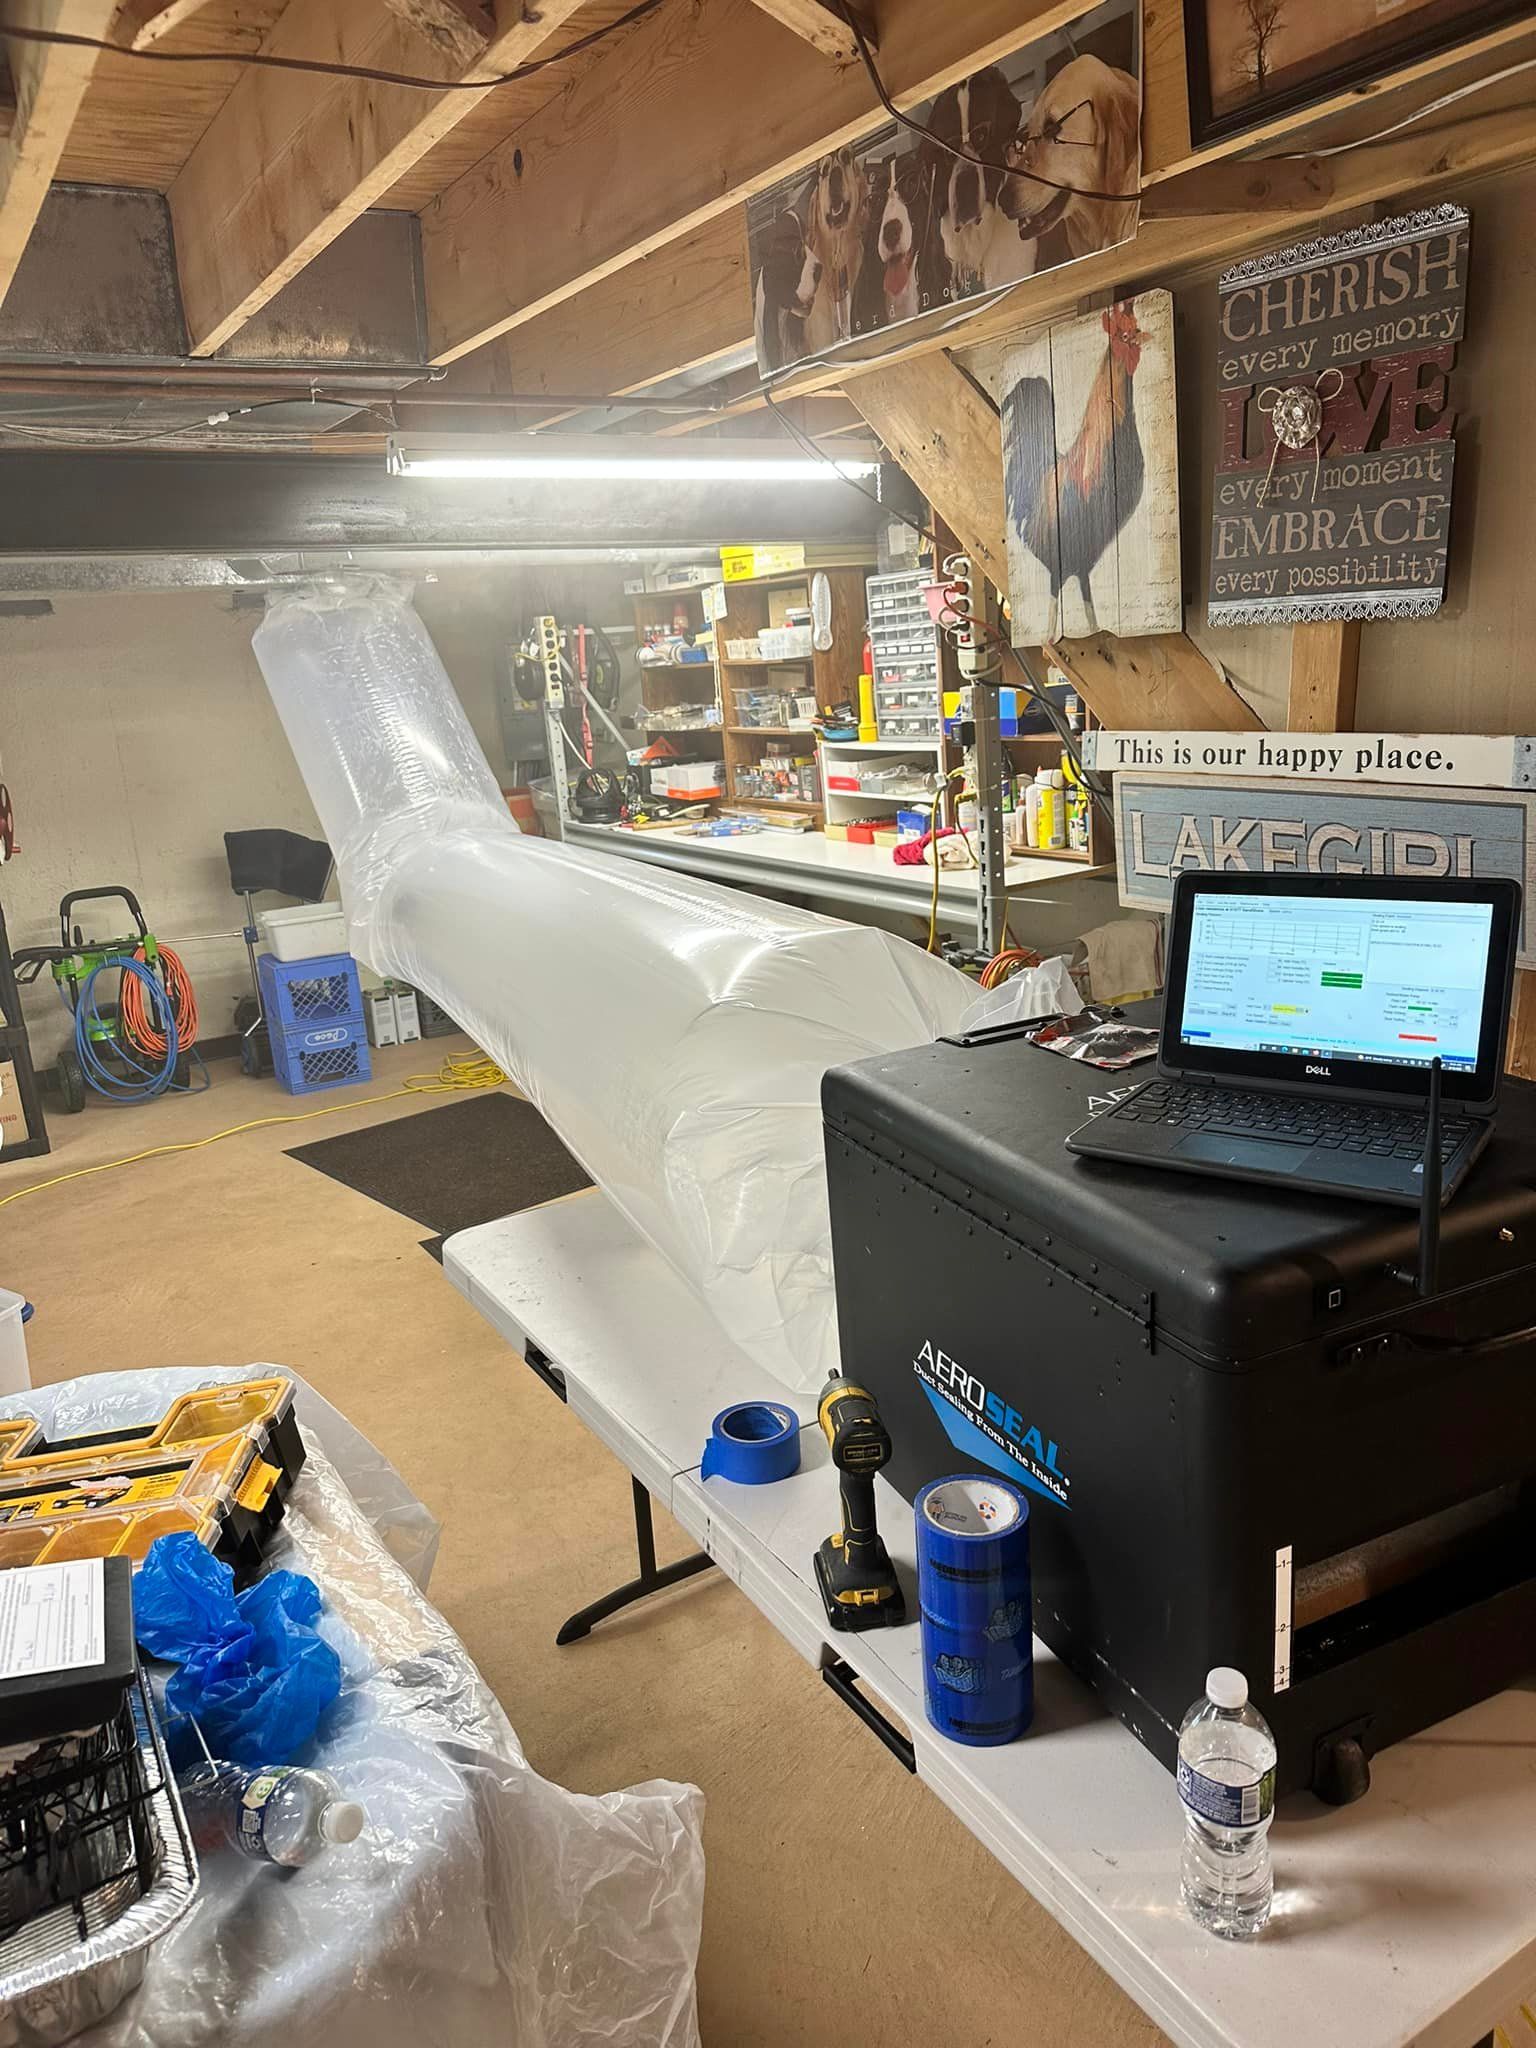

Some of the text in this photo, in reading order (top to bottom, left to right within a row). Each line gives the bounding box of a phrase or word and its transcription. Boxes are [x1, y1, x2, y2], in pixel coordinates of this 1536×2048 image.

[1222, 230, 1464, 343] CHERISH
[1221, 305, 1461, 381] every memory
[1219, 448, 1443, 506] every moment
[1214, 494, 1446, 561] EMBRACE
[1214, 553, 1441, 595] every possibility
[1114, 738, 1455, 775] This is our happy place.
[1305, 1064, 1332, 1076] DELL
[912, 1359, 1069, 1501] Duct Sealing From The Inside
[917, 1339, 1064, 1479] AEROSEAL
